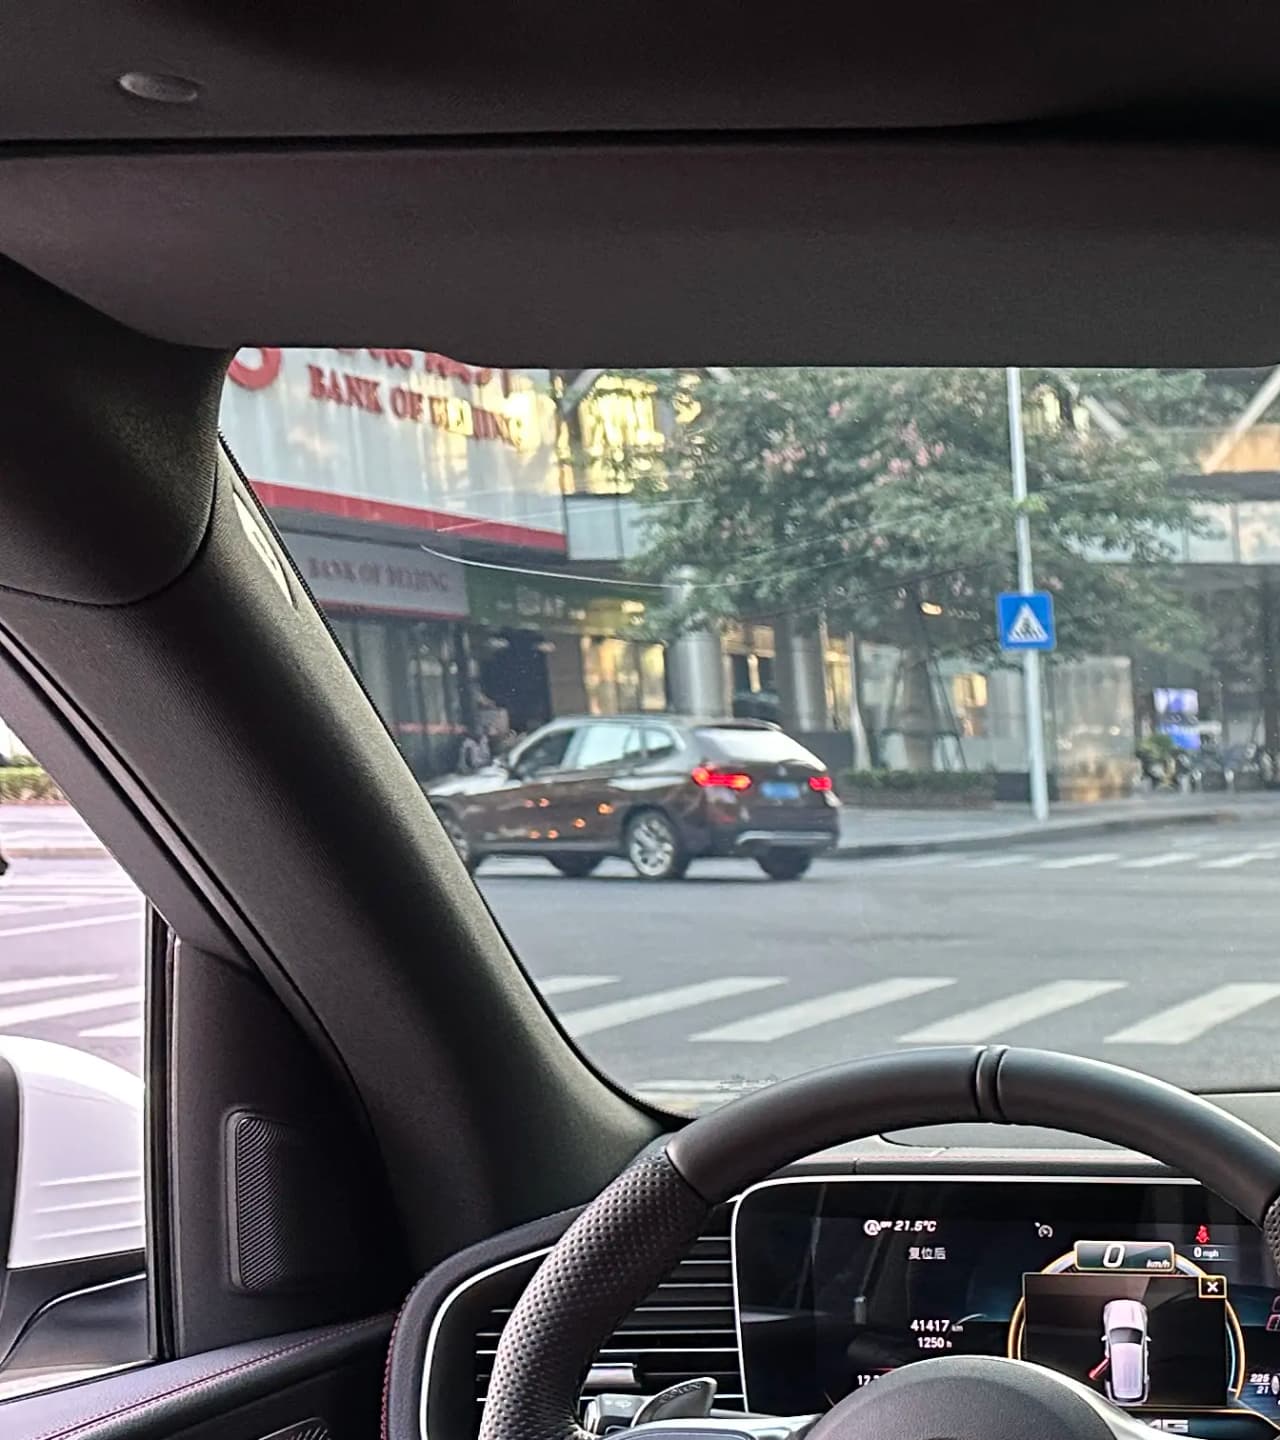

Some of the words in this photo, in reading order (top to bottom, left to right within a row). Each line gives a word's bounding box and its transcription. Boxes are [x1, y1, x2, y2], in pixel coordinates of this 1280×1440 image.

[307, 364, 384, 414] BANK
[390, 386, 424, 421] OF
[907, 1246, 947, 1261] 复位后
[1102, 1243, 1126, 1268] 0
[1146, 1258, 1171, 1269] km/h
[1193, 1246, 1202, 1258] 0
[909, 1319, 951, 1332] 41417
[917, 1336, 945, 1349] 1250
[1256, 1385, 1269, 1395] 21
